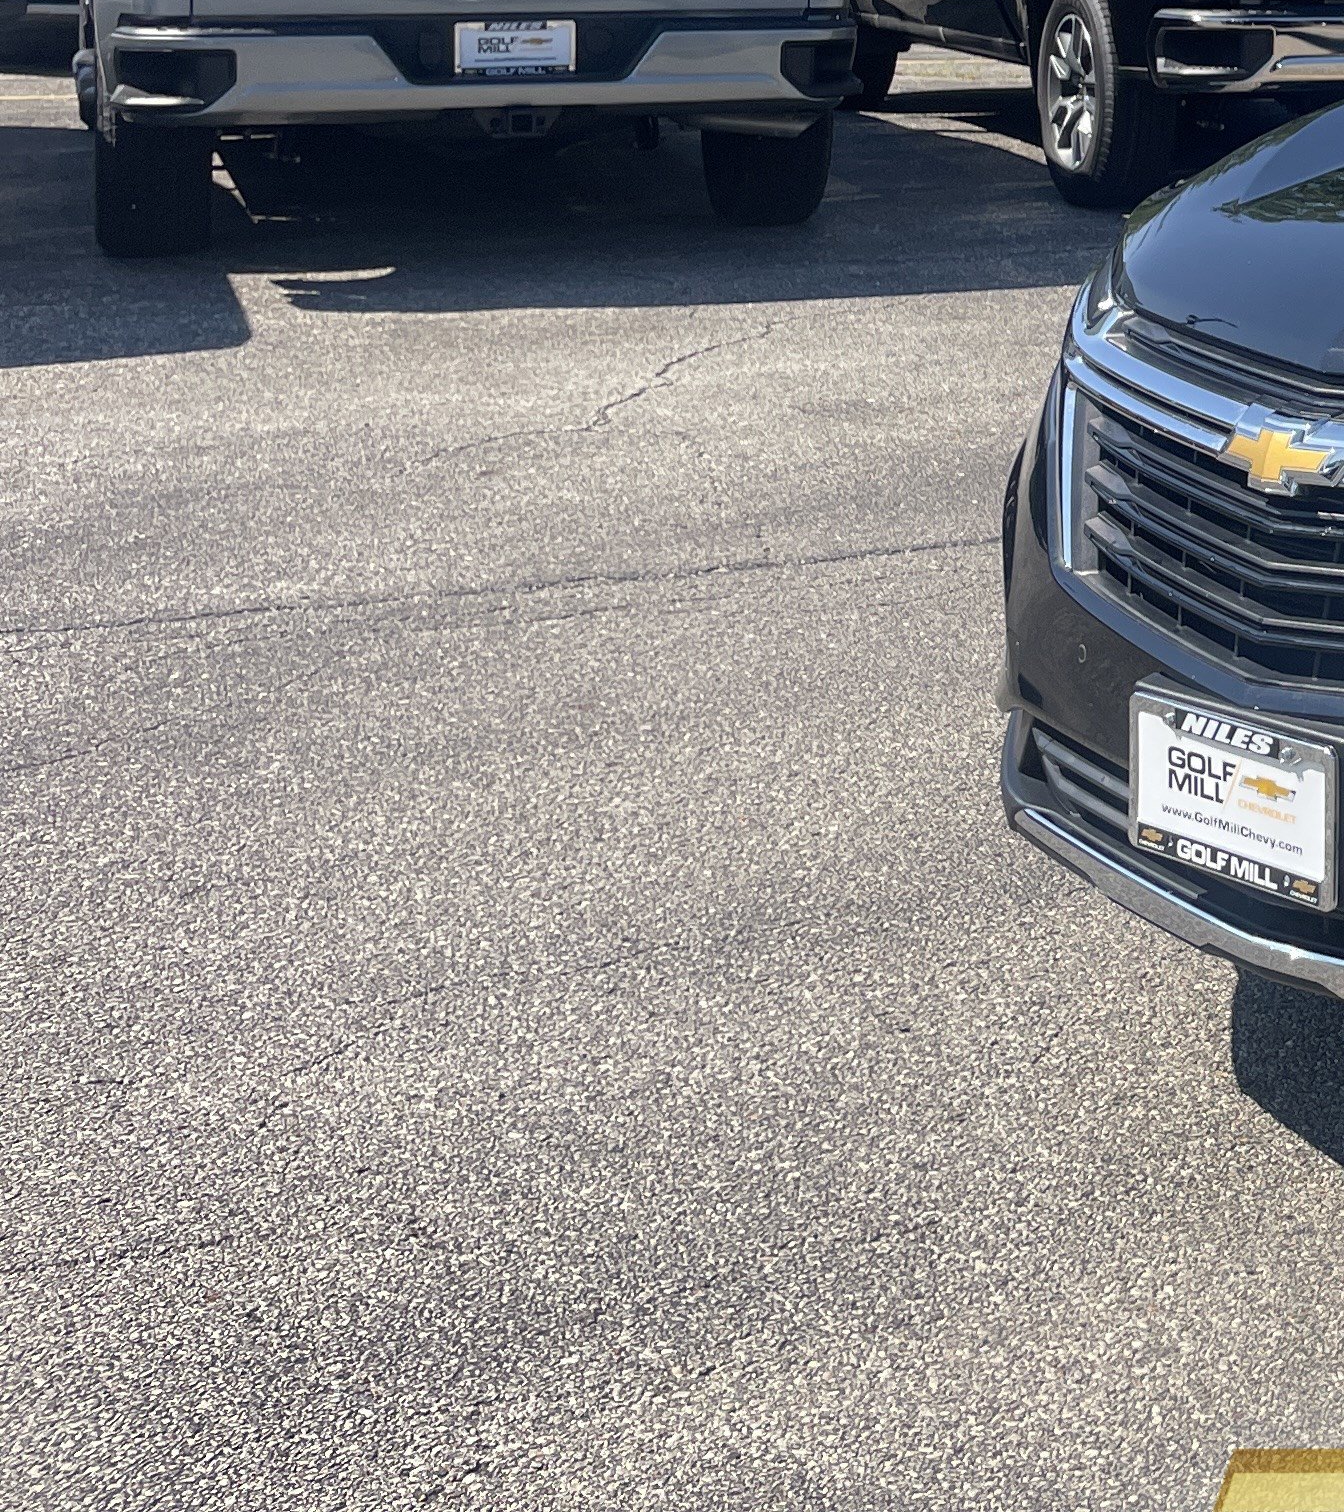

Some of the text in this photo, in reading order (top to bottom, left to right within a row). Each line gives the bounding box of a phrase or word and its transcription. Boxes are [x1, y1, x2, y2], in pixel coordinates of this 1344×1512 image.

[1180, 712, 1274, 756] NILES
[1167, 745, 1237, 782] GOLF
[1167, 767, 1225, 804] MILL
[1161, 803, 1304, 856] www.GolfMillChevy.com
[1176, 838, 1278, 891] GOLF MILL
